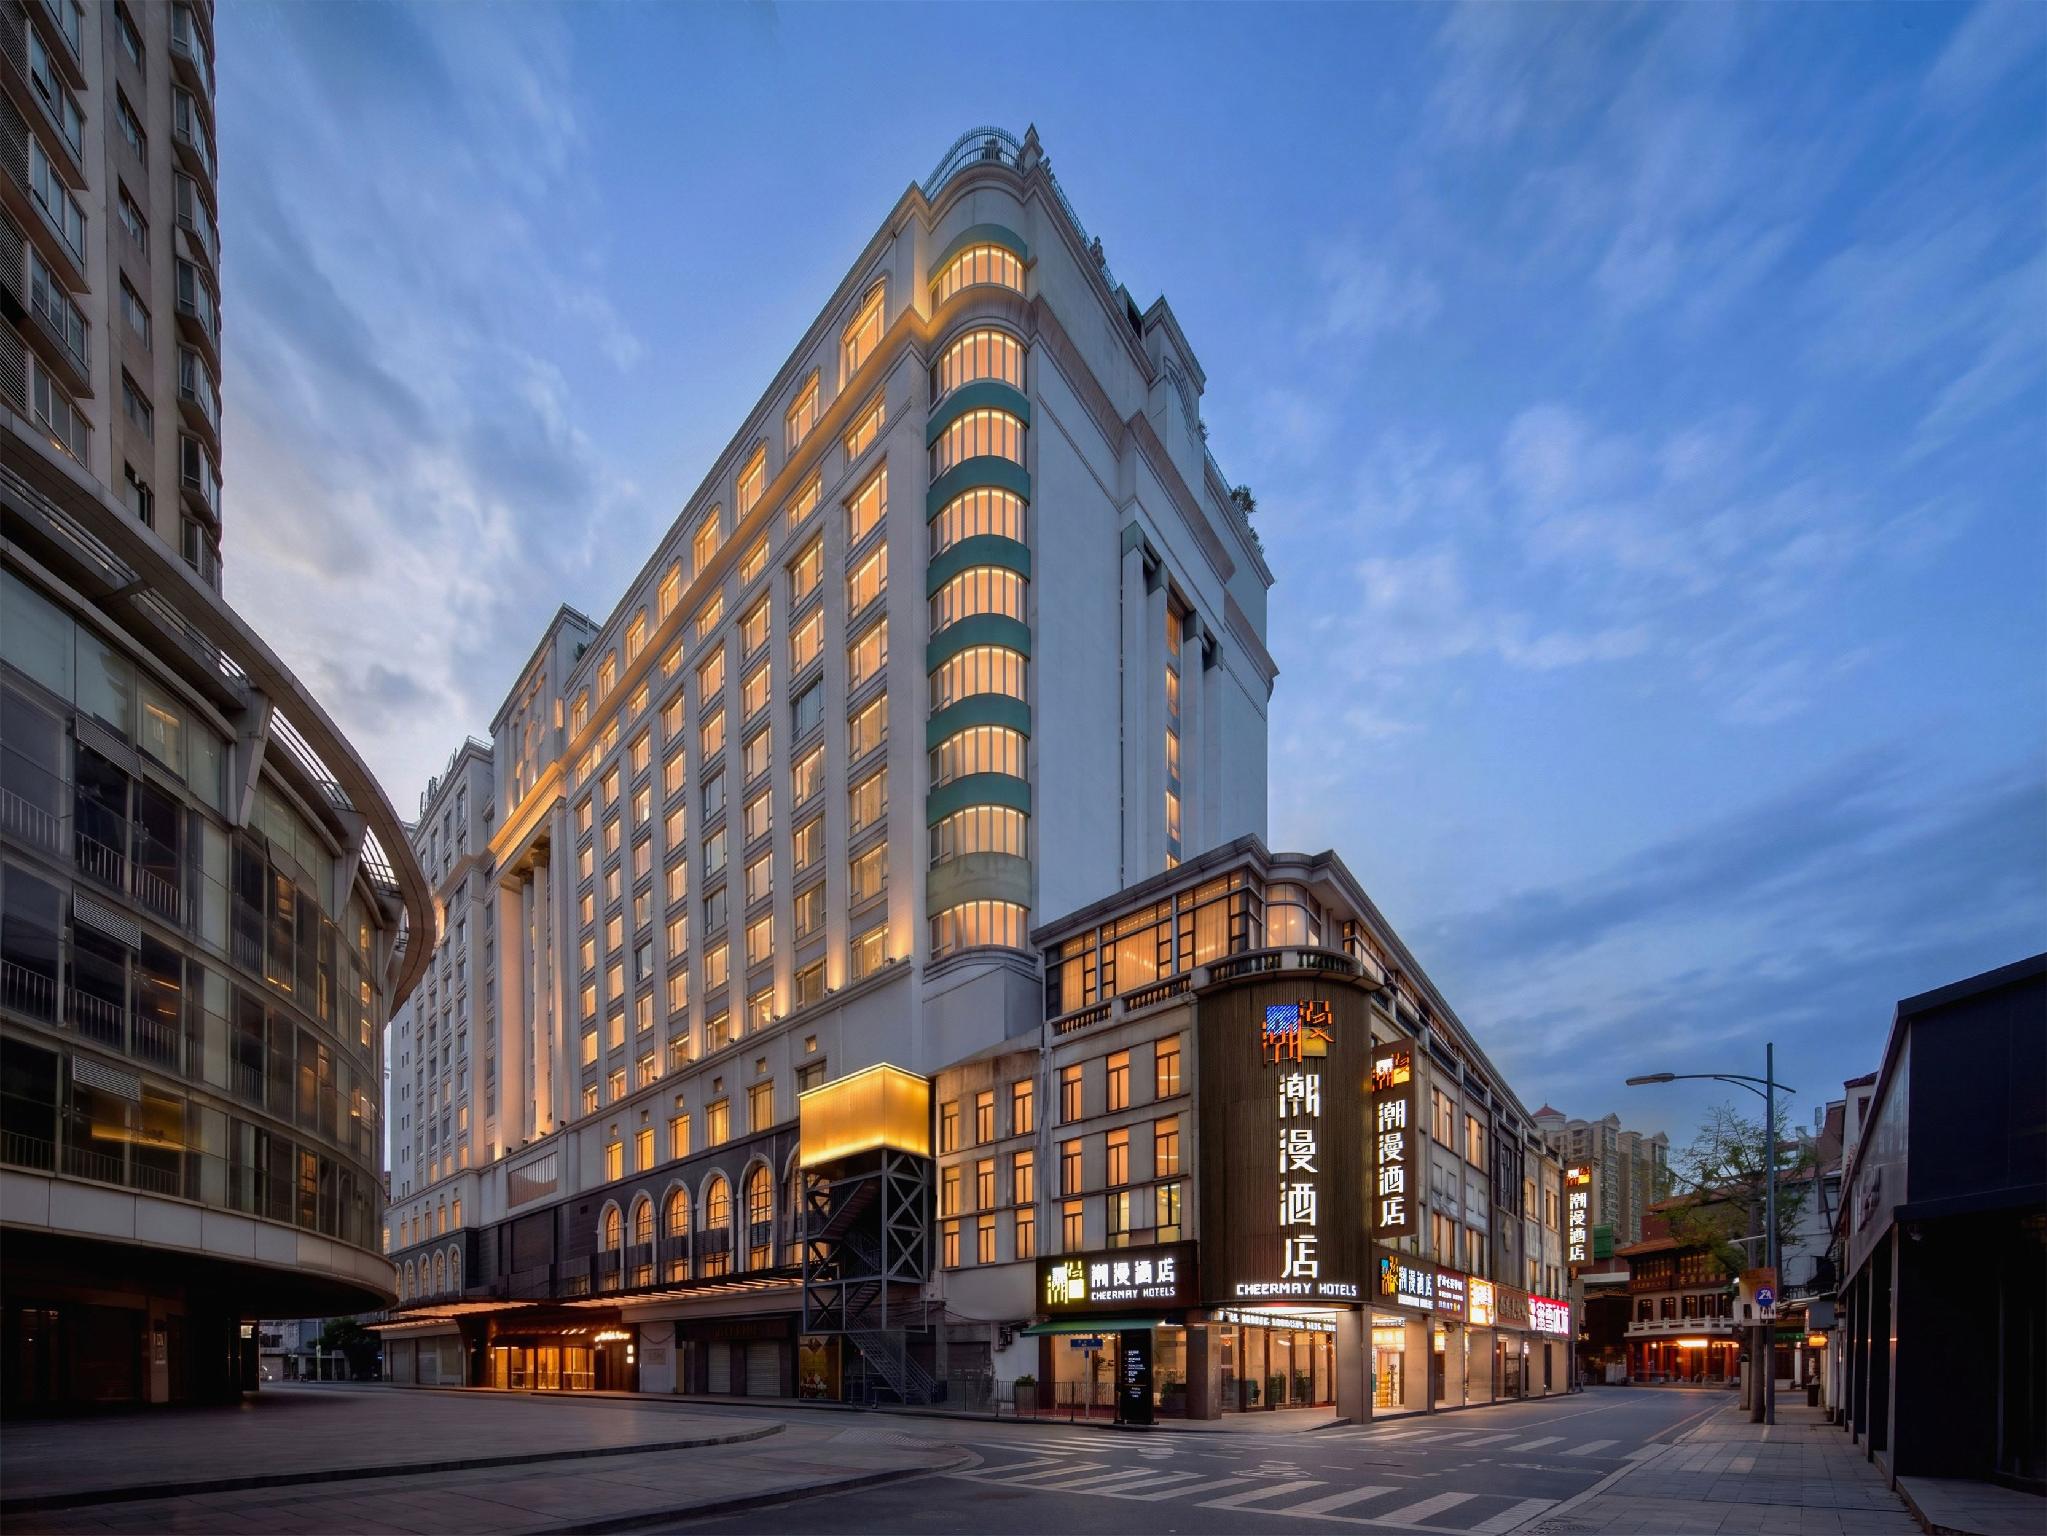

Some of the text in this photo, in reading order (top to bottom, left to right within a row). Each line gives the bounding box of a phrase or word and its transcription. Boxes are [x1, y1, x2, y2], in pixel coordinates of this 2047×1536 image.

[1279, 1073, 1320, 1279] 潮漫酒店
[1378, 1099, 1406, 1228] 潮漫酒店
[1569, 1192, 1587, 1262] 潮漫酒店
[1091, 1257, 1175, 1288] 潮漫酒店
[1091, 1286, 1175, 1300] CHEERMAY HOTELS
[1236, 1282, 1357, 1297] CHEERMAY HOTELS
